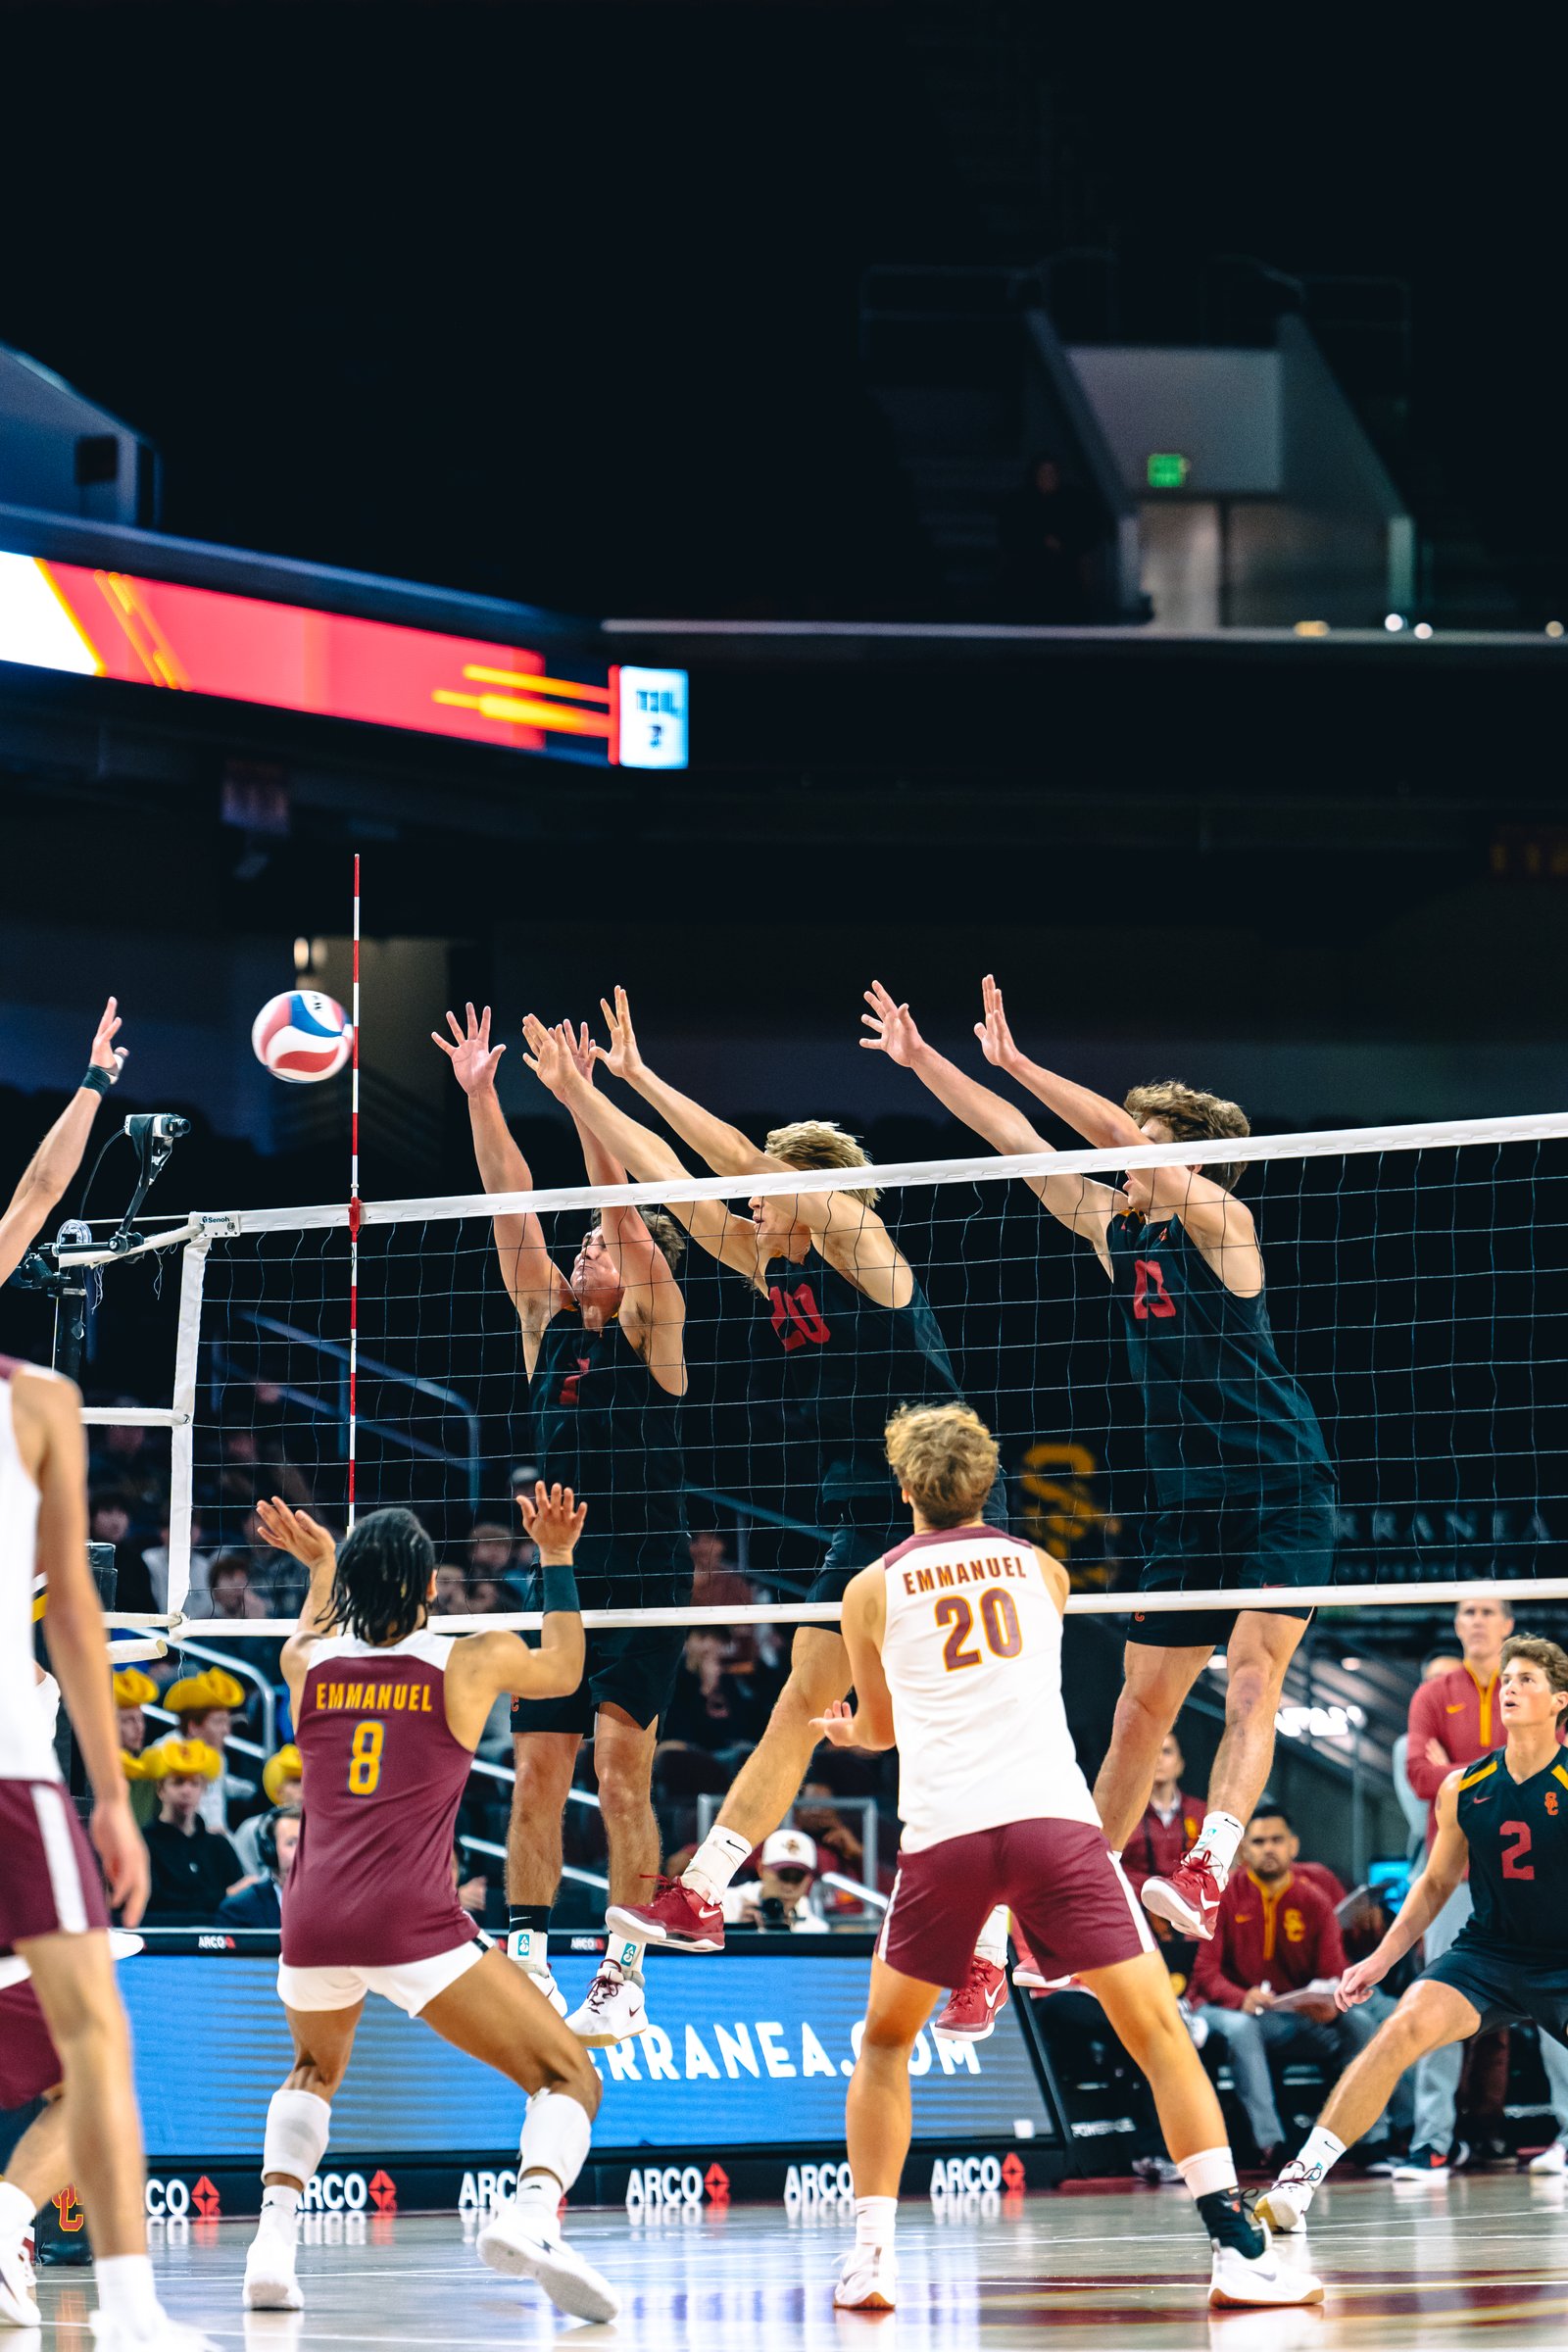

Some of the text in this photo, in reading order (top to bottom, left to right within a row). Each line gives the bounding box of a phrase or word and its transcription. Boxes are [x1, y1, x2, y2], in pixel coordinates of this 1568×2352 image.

[902, 1556, 1027, 1595] EMMANUEL
[934, 1587, 1023, 1672] 20
[316, 1683, 432, 1712] EMMANUEL
[348, 1719, 385, 1796] 8
[1499, 1820, 1535, 1880] 2
[198, 1935, 226, 1949] ARCO
[626, 2166, 704, 2204] ARCO
[784, 2161, 854, 2200] ARCO
[931, 2156, 1002, 2192] ARCO
